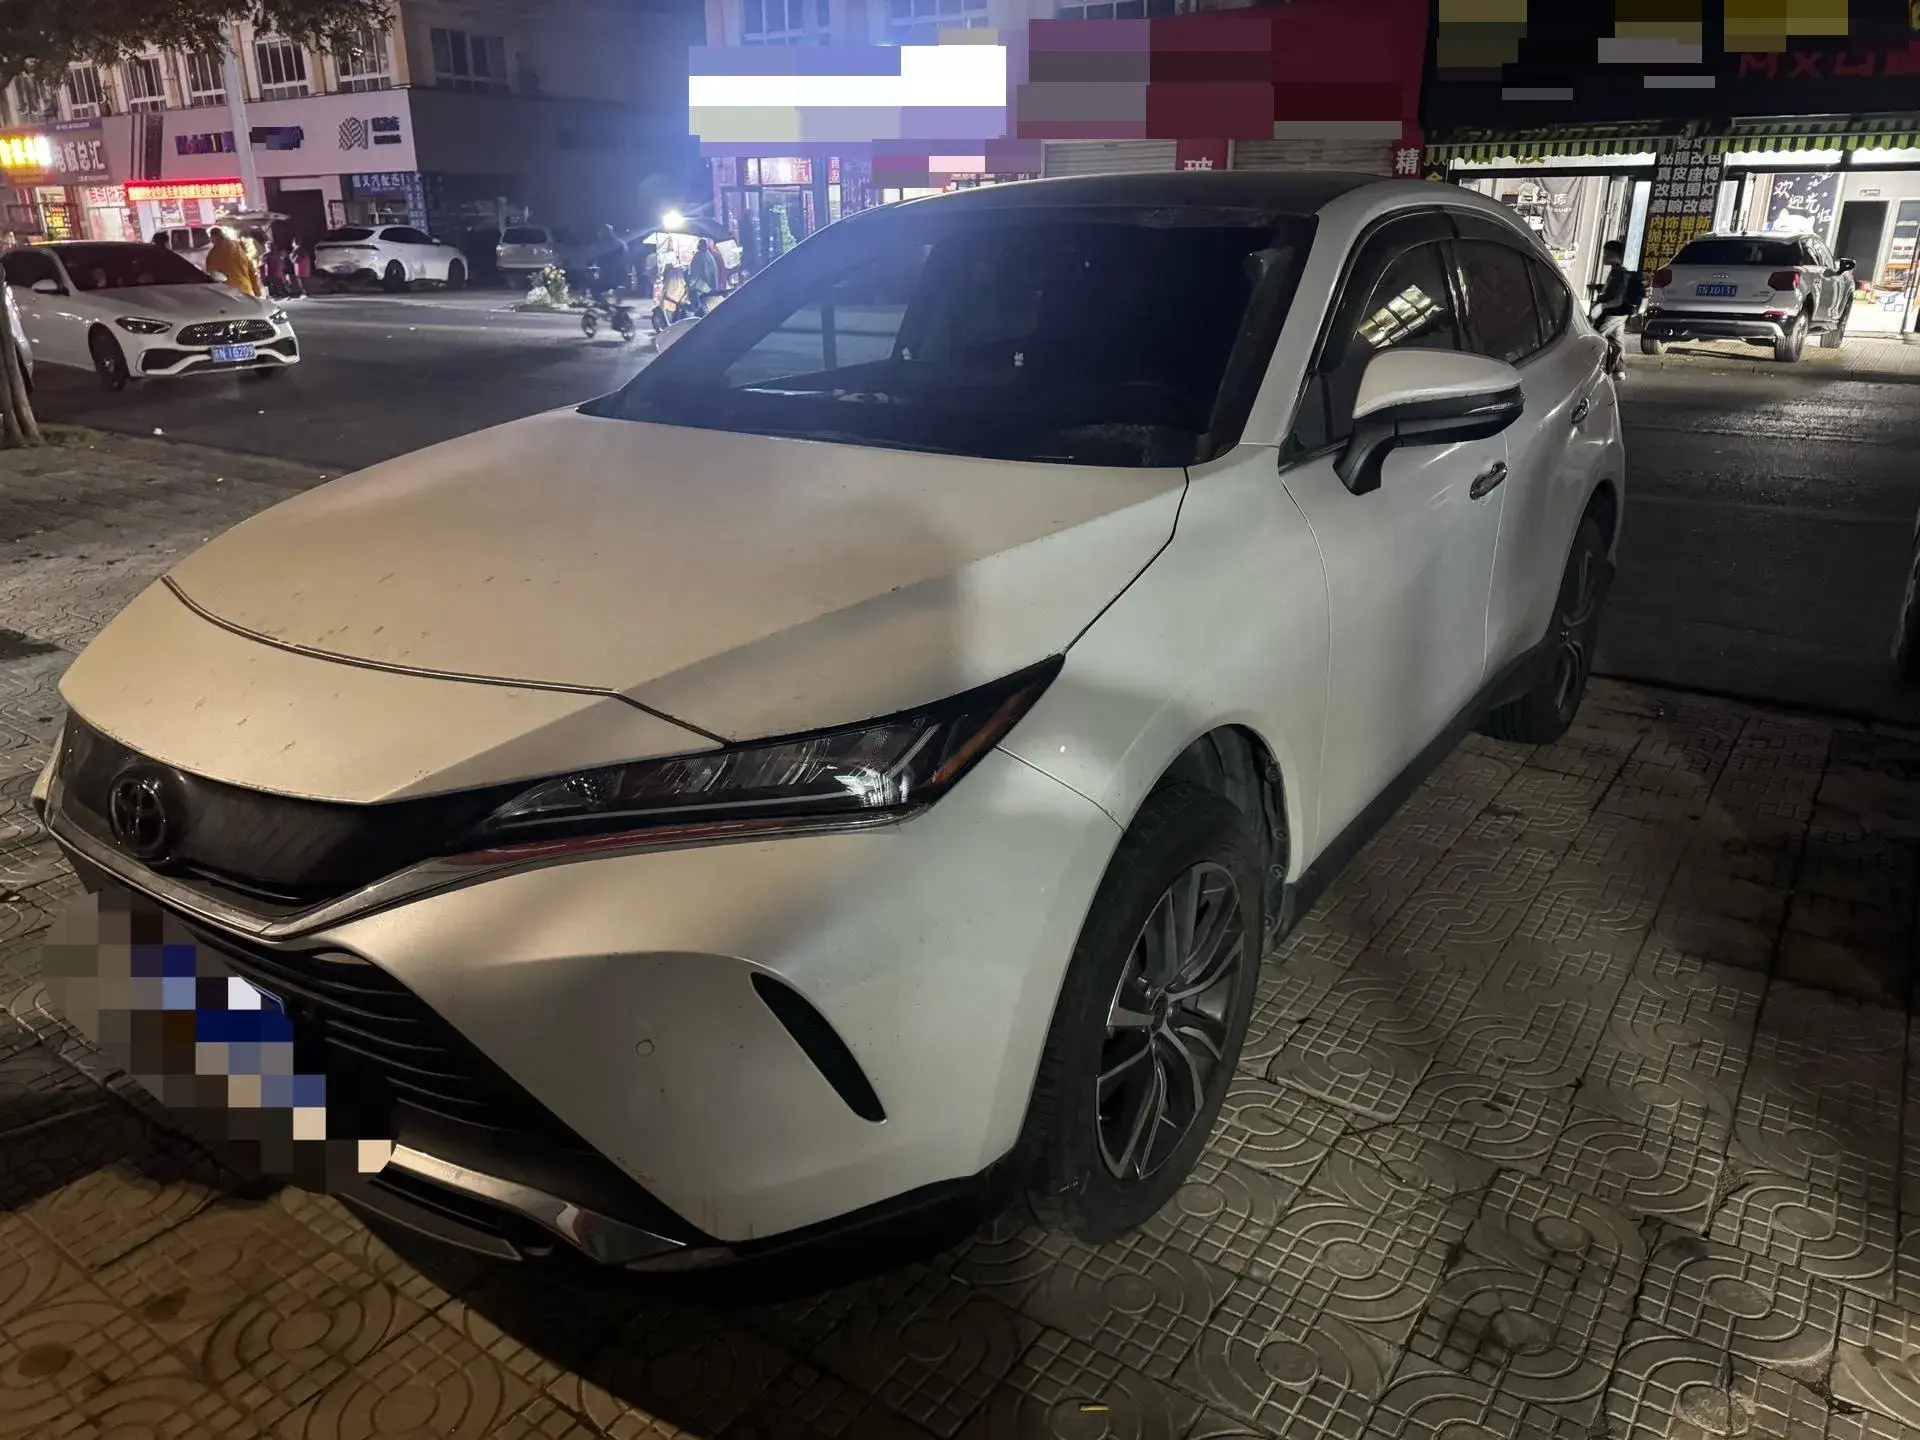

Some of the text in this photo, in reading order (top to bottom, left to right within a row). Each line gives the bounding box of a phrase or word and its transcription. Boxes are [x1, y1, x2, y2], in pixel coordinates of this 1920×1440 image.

[1396, 149, 1420, 175] 精
[1659, 151, 1722, 165] 贴膜改色
[1656, 166, 1720, 181] 真皮座椅
[1653, 181, 1718, 197] 改氛围灯
[1649, 198, 1715, 213] 音响改装
[1649, 215, 1711, 231] 内饰翻新
[1647, 229, 1704, 244] 抛光打
